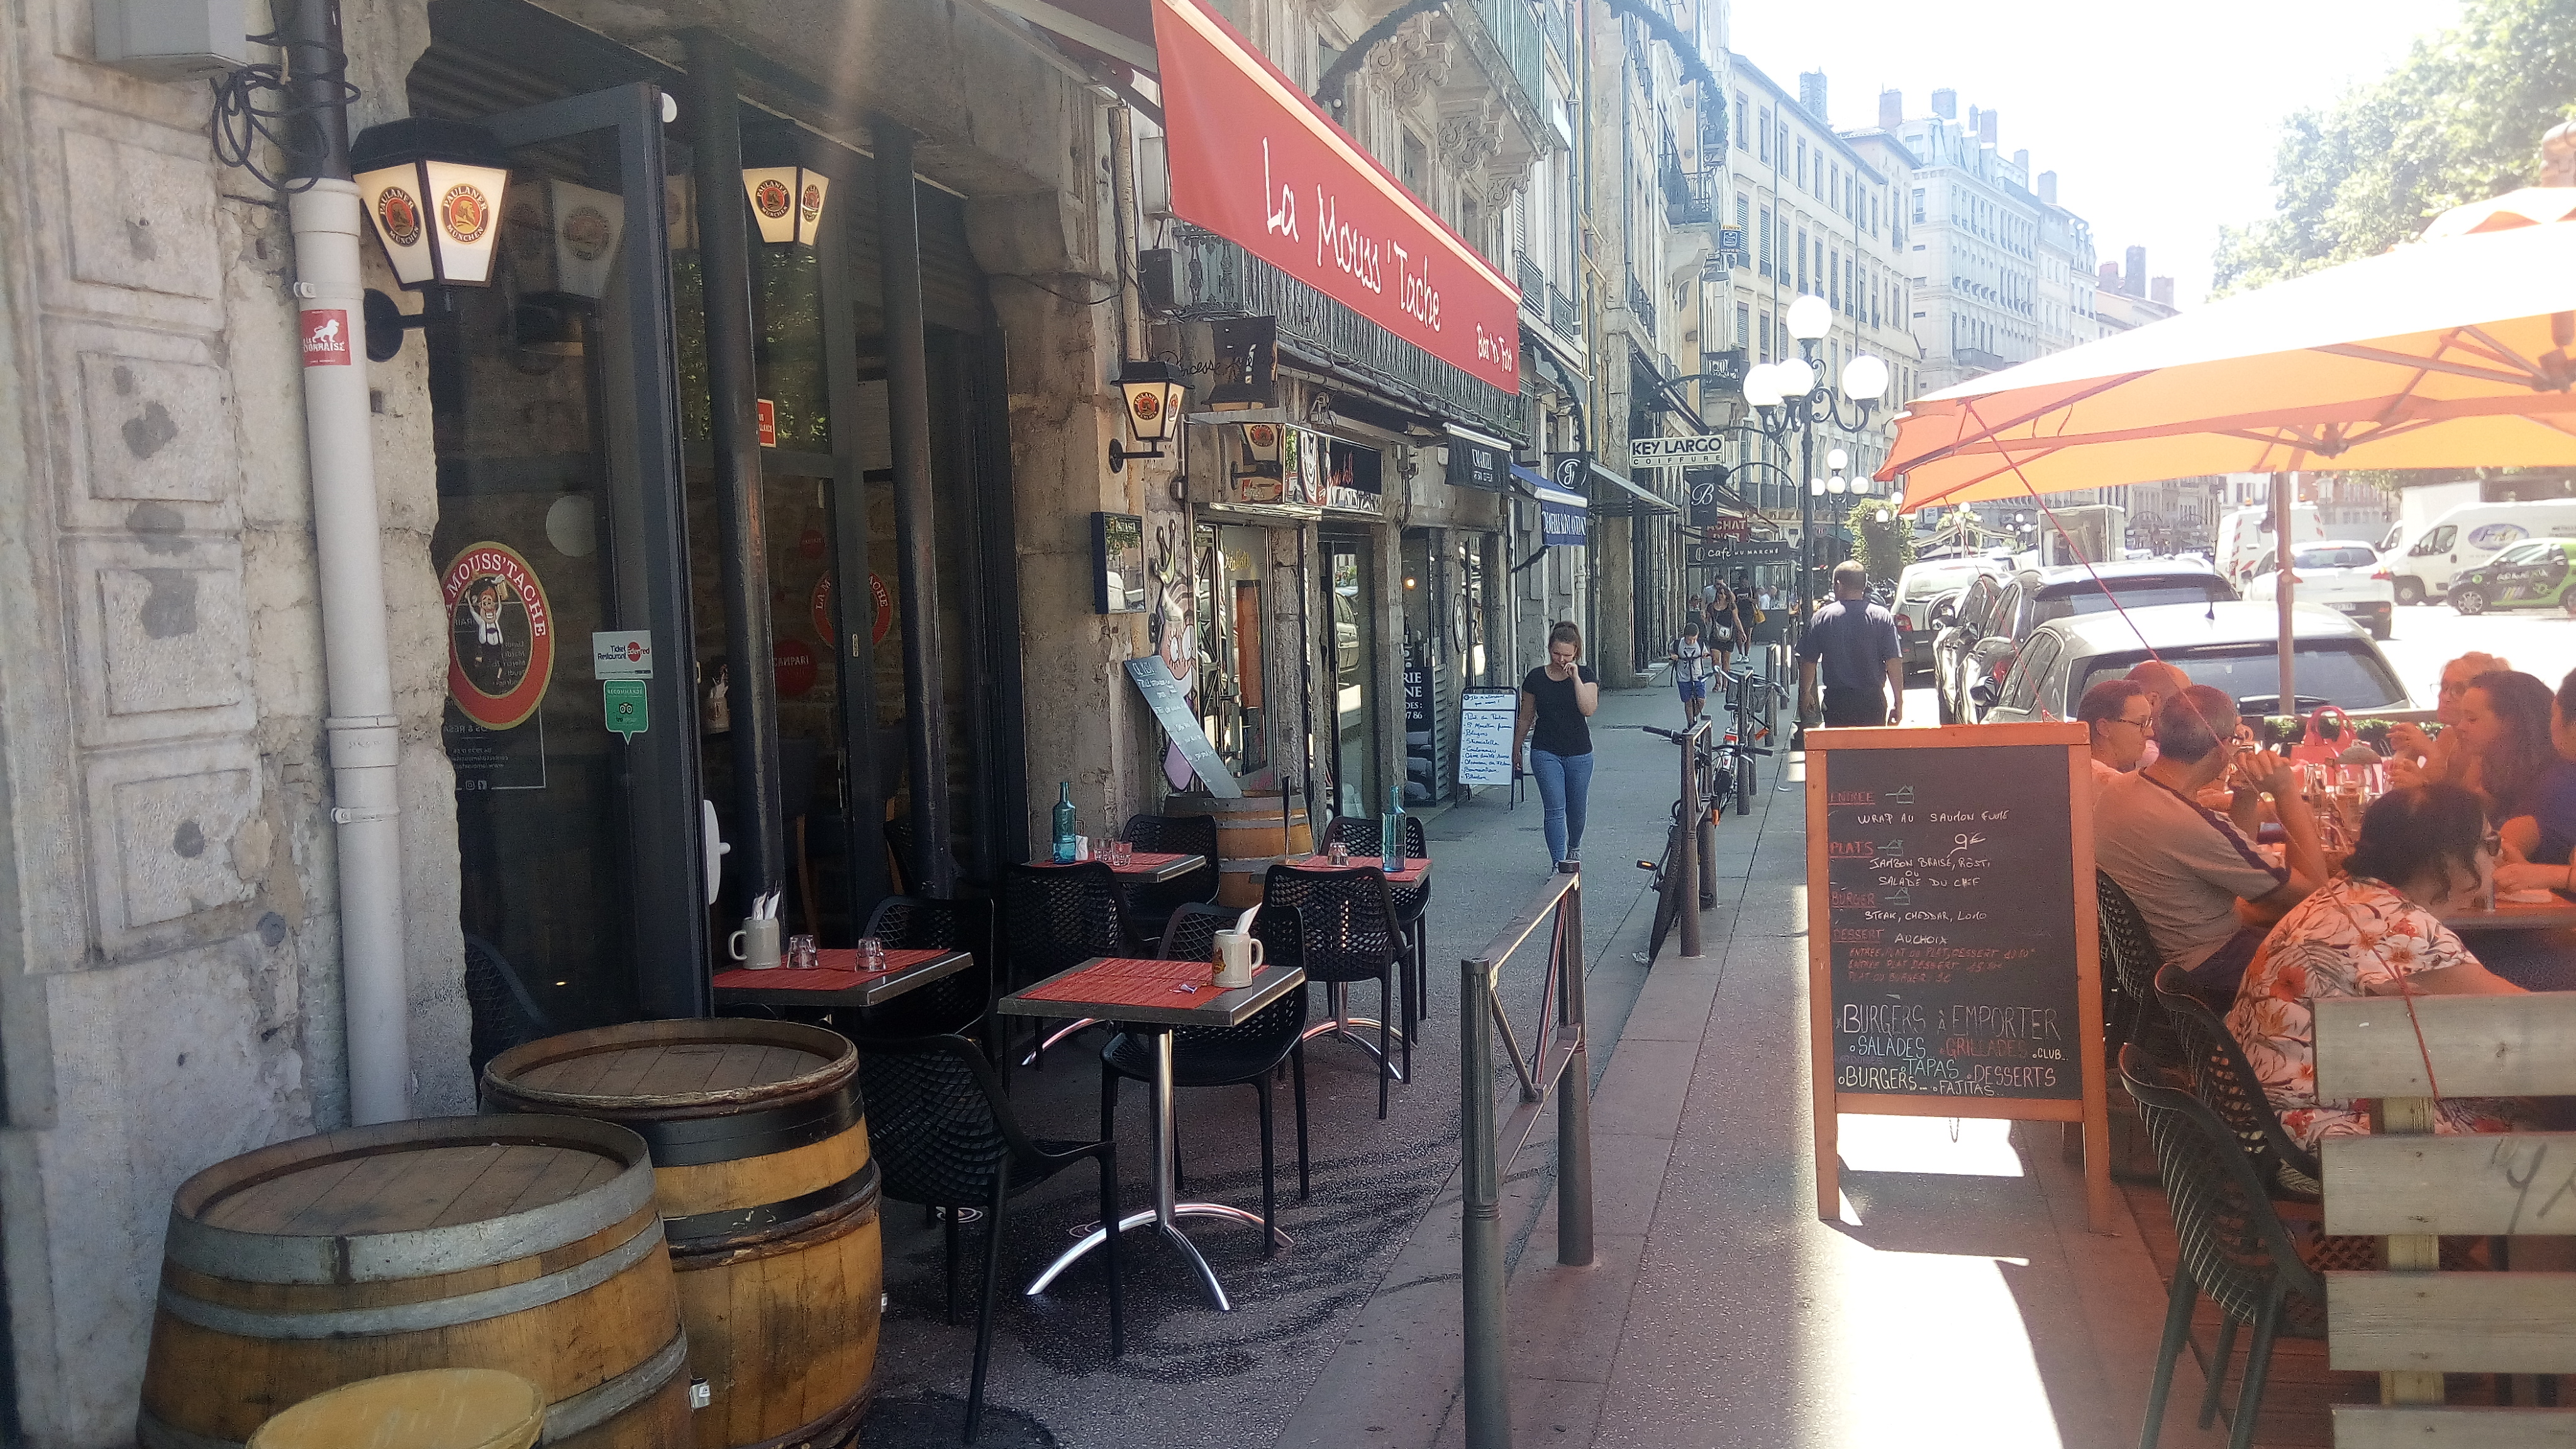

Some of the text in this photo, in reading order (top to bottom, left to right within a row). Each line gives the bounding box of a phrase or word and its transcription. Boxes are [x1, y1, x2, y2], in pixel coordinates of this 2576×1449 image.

[757, 180, 788, 197] PAULANER
[1262, 136, 1299, 243] La
[379, 188, 414, 215] PAULANER
[443, 186, 487, 211] PAULANER
[1633, 438, 1722, 455] KEY LARGO
[1633, 455, 1721, 465] COIFFURE
[628, 647, 650, 655] Edenred
[1901, 813, 1914, 823] AU
[1929, 810, 1974, 823] SAUMON
[1869, 858, 1913, 870] JAMBON
[1879, 877, 1981, 887] SALADE DU CHEF
[1831, 892, 1876, 906] BURGER
[1843, 1004, 1926, 1035] BURGERS
[1952, 1005, 2062, 1041] EMPORTER
[1902, 1058, 2057, 1087] TAPAS DESSERTS
